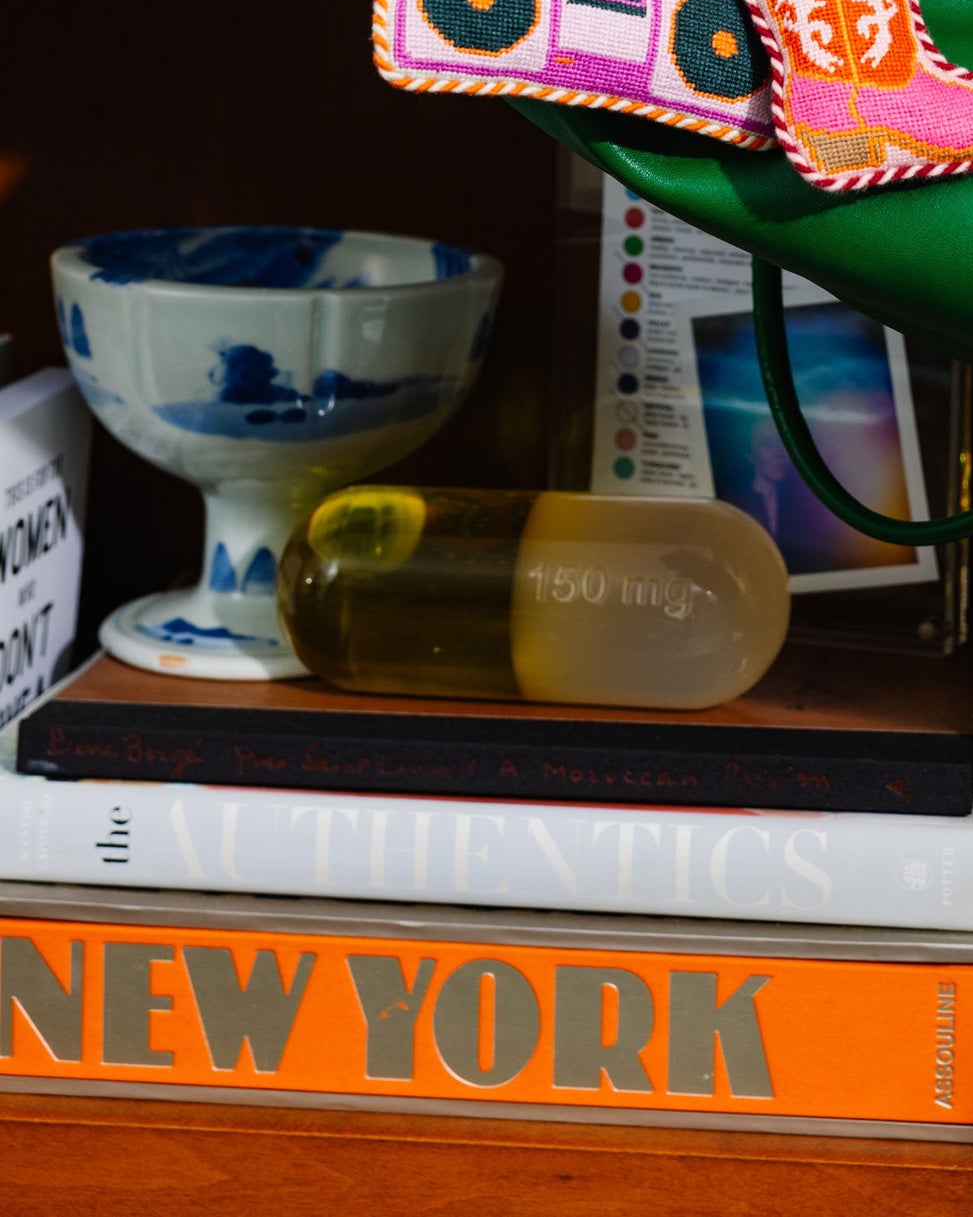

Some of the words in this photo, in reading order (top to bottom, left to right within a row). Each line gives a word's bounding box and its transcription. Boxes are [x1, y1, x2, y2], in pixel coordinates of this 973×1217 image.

[529, 564, 606, 606] 150
[621, 570, 696, 619] mg
[96, 804, 132, 864] the
[167, 796, 834, 912] AUTHENTICS
[0, 935, 317, 1074] NEW
[346, 954, 774, 1100] YORK
[933, 981, 957, 1109] ASSOULINE
